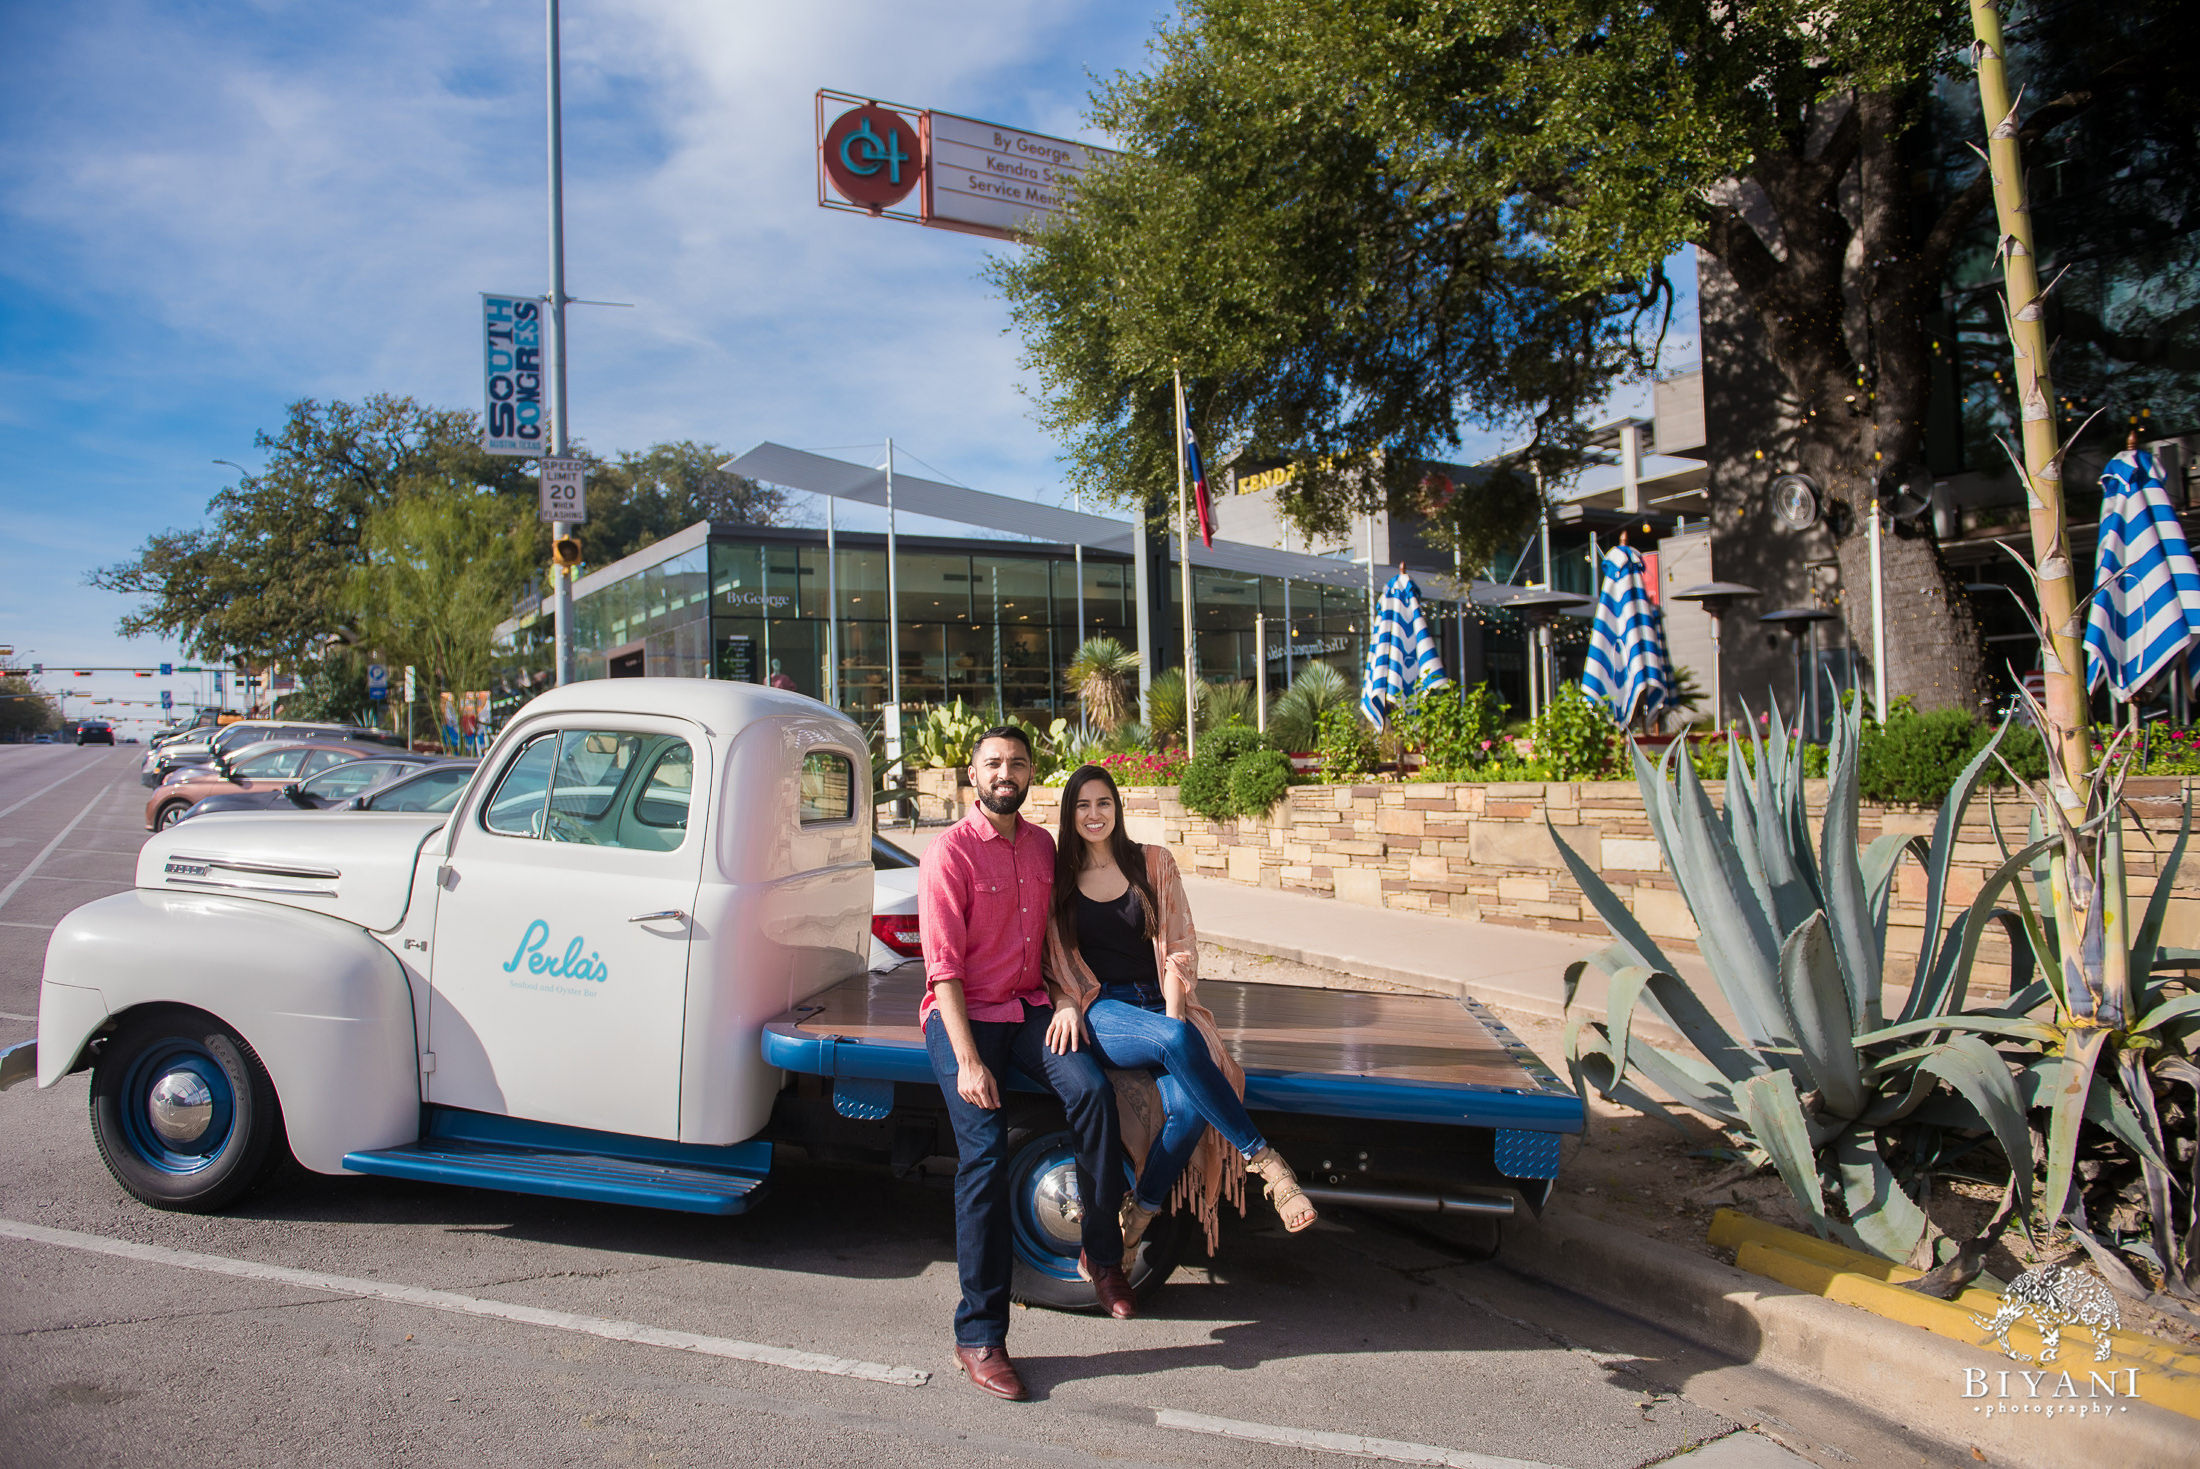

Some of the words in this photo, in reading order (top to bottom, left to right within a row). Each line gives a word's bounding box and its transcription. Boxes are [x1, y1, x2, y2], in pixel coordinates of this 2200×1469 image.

[994, 132, 1012, 152] By
[1016, 138, 1070, 163] George
[987, 156, 1038, 180] Kendra
[969, 175, 1020, 198] Service
[487, 299, 514, 437] SOUTH
[514, 302, 541, 439] CONGRESS
[542, 461, 582, 470] SPEED
[547, 472, 577, 481] LIMIT
[550, 485, 576, 500] 20
[503, 918, 608, 983] Perla's
[539, 983, 554, 993] and
[555, 985, 582, 997] Oyster
